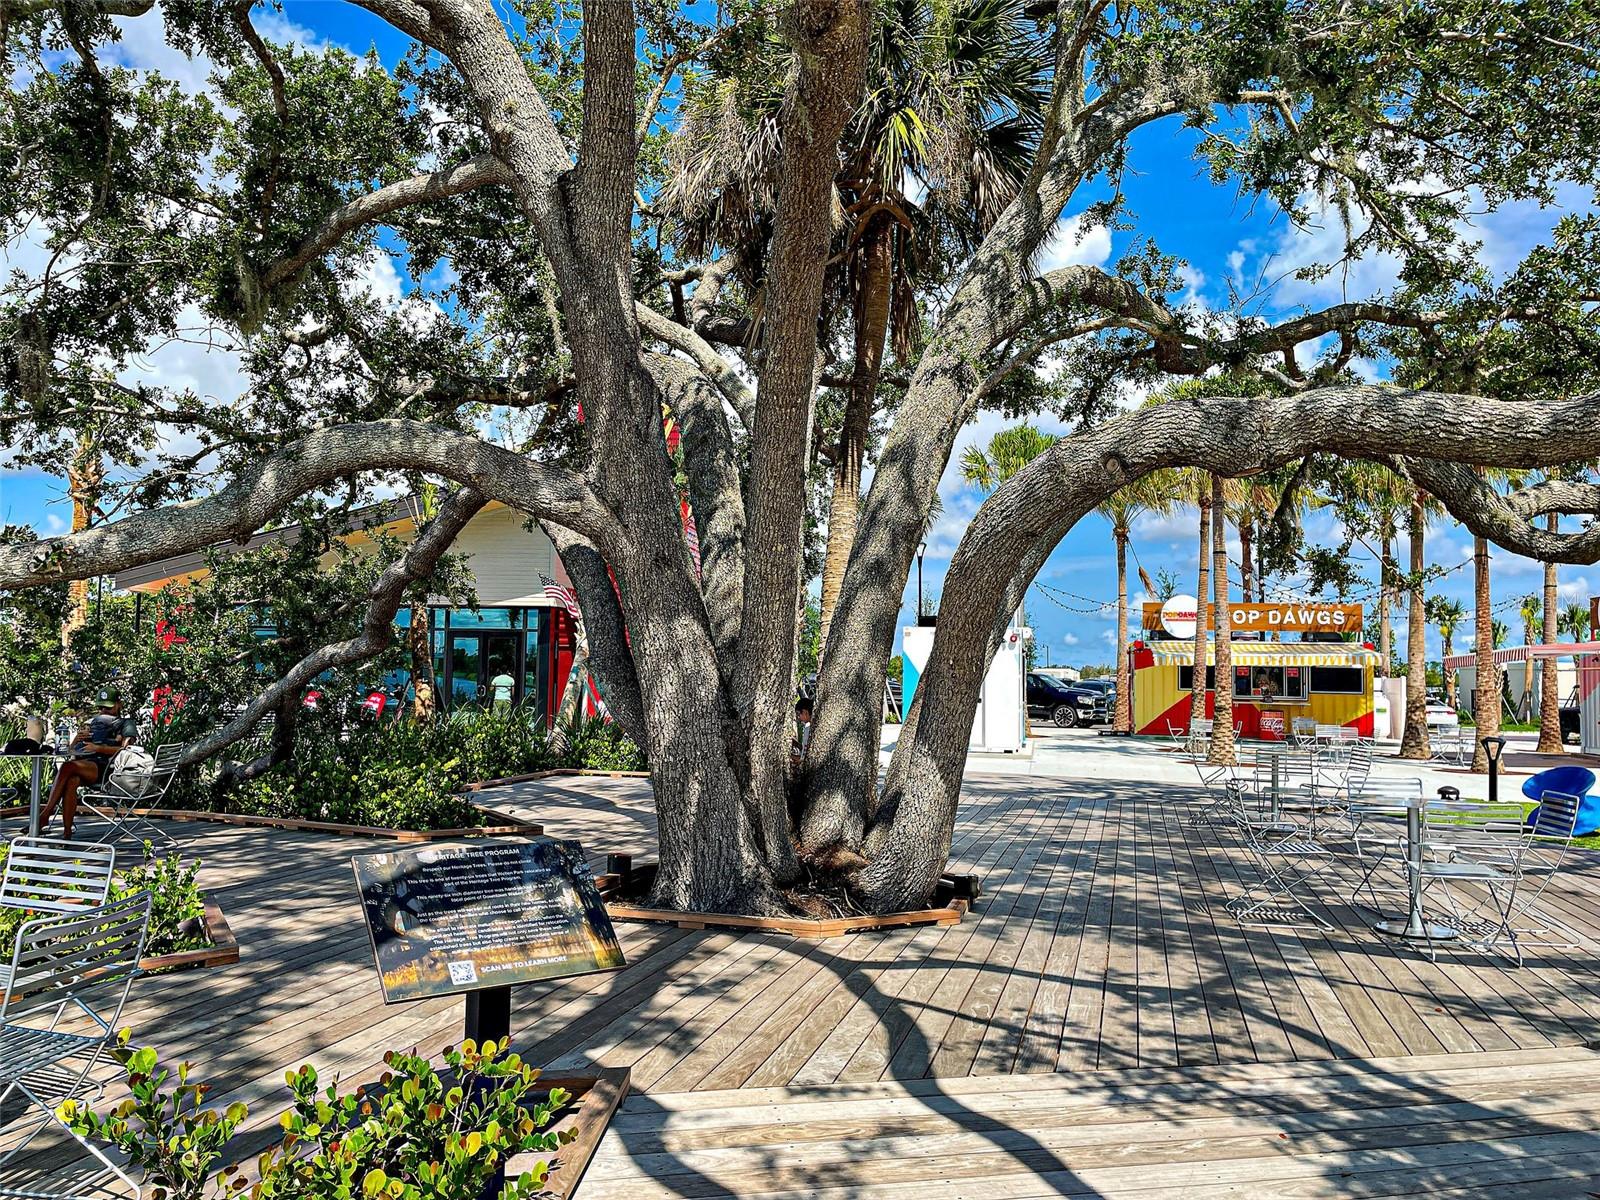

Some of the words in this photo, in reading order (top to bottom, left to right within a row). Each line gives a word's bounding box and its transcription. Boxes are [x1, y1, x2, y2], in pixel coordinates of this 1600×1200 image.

[1232, 609, 1260, 625] OP
[1268, 609, 1346, 625] DAWGS
[480, 965, 502, 973] SCAN
[524, 958, 548, 966] LEARN
[547, 955, 568, 963] MORE
